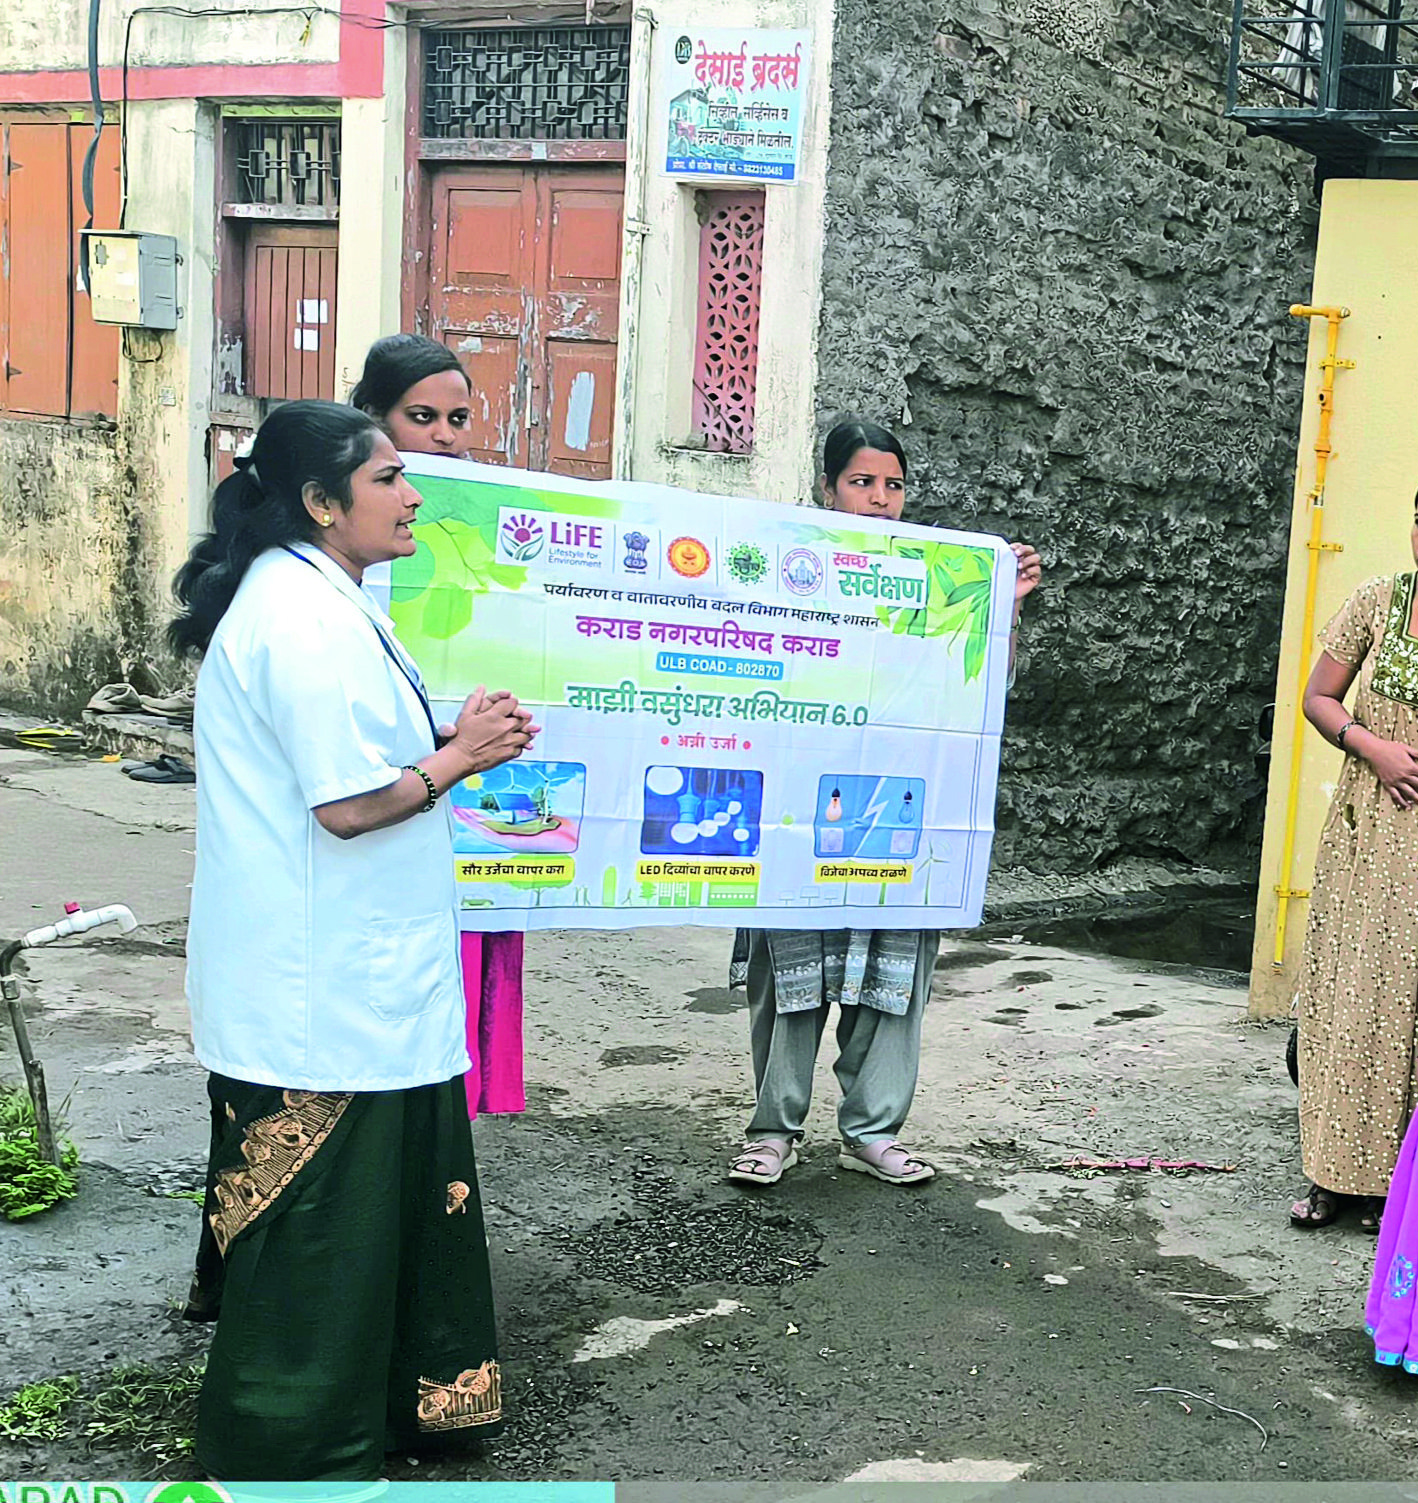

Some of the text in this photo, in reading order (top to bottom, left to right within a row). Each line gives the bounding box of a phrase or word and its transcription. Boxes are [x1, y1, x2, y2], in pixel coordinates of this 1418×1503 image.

[695, 39, 801, 94] देसाई ब्रदर्स
[550, 521, 602, 549] LiFE
[548, 555, 602, 569] Environment
[549, 547, 598, 560] Lifestyle for
[833, 552, 868, 569] स्वच्छ
[838, 563, 924, 603] सर्वेक्षण
[543, 582, 608, 600] पर्यावरण
[611, 590, 622, 601] व
[627, 591, 707, 610] वातावरणीय
[747, 601, 788, 618] विभाग
[790, 608, 841, 626] महाराष्ट्र
[843, 613, 880, 628] शासन
[576, 615, 840, 658] कराड नगरपरिषद कराड
[659, 656, 687, 670] ULB
[735, 663, 780, 678] 802870
[567, 680, 868, 727] माझी वसुंधरा अभियान 6.0
[709, 733, 737, 750] उर्जा
[461, 862, 482, 876] सौर
[516, 865, 544, 875] वापर
[545, 865, 565, 875] करा
[640, 862, 755, 876] LED दिव्यांचा वापर करणे
[820, 865, 848, 877] विजेचा
